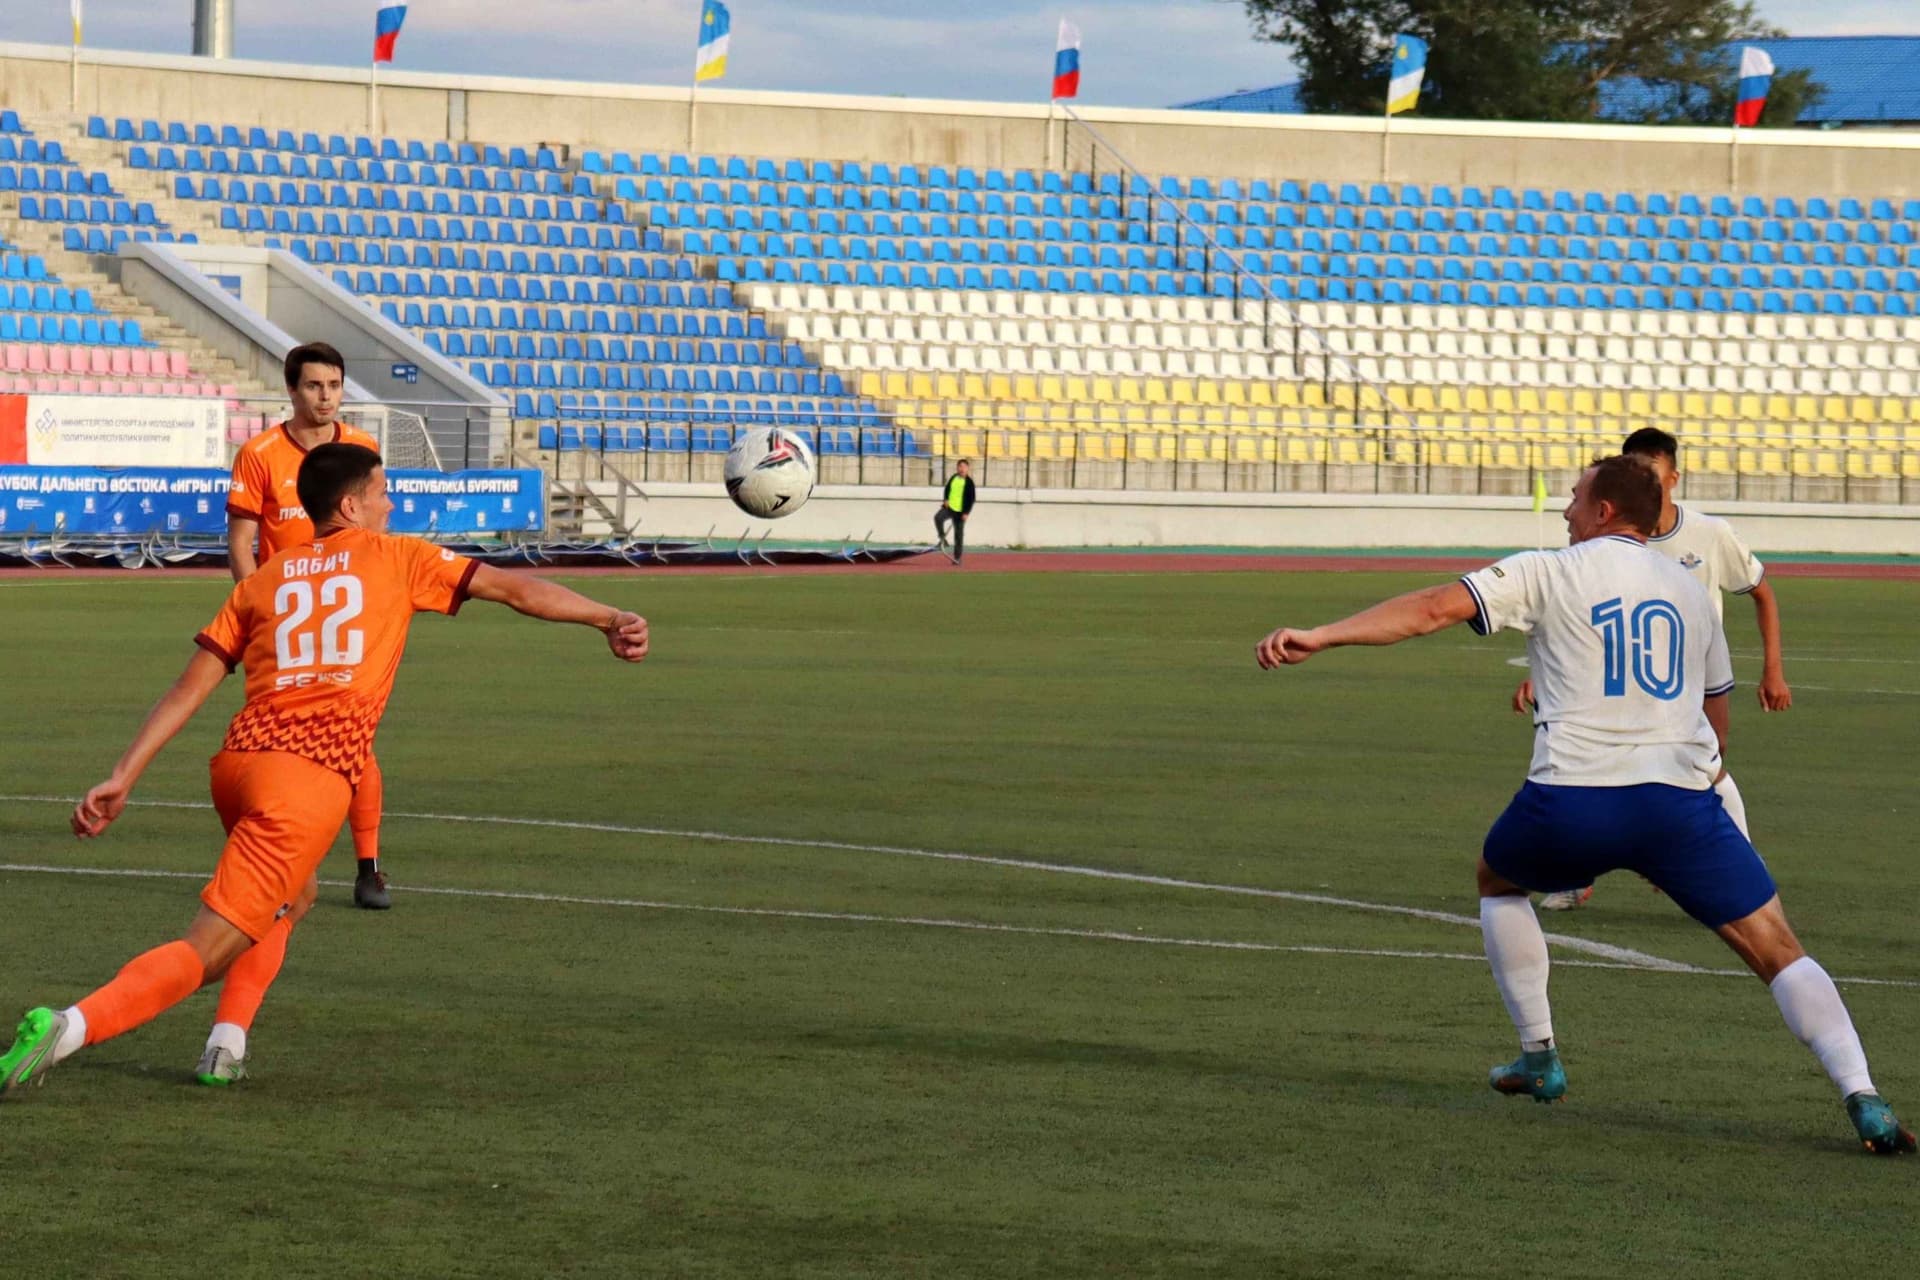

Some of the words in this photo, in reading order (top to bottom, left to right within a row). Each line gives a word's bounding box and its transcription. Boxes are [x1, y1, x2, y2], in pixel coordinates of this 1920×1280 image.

[40, 476, 108, 493] ДАЛЬНЕГО
[110, 477, 168, 493] ВОСТОКА
[396, 479, 465, 493] РЕСПУБЛИКА
[467, 479, 519, 493] БУРЯТИЯ
[283, 551, 350, 579] БАБИЧ
[274, 575, 364, 671] 22
[1591, 597, 1685, 700] 10
